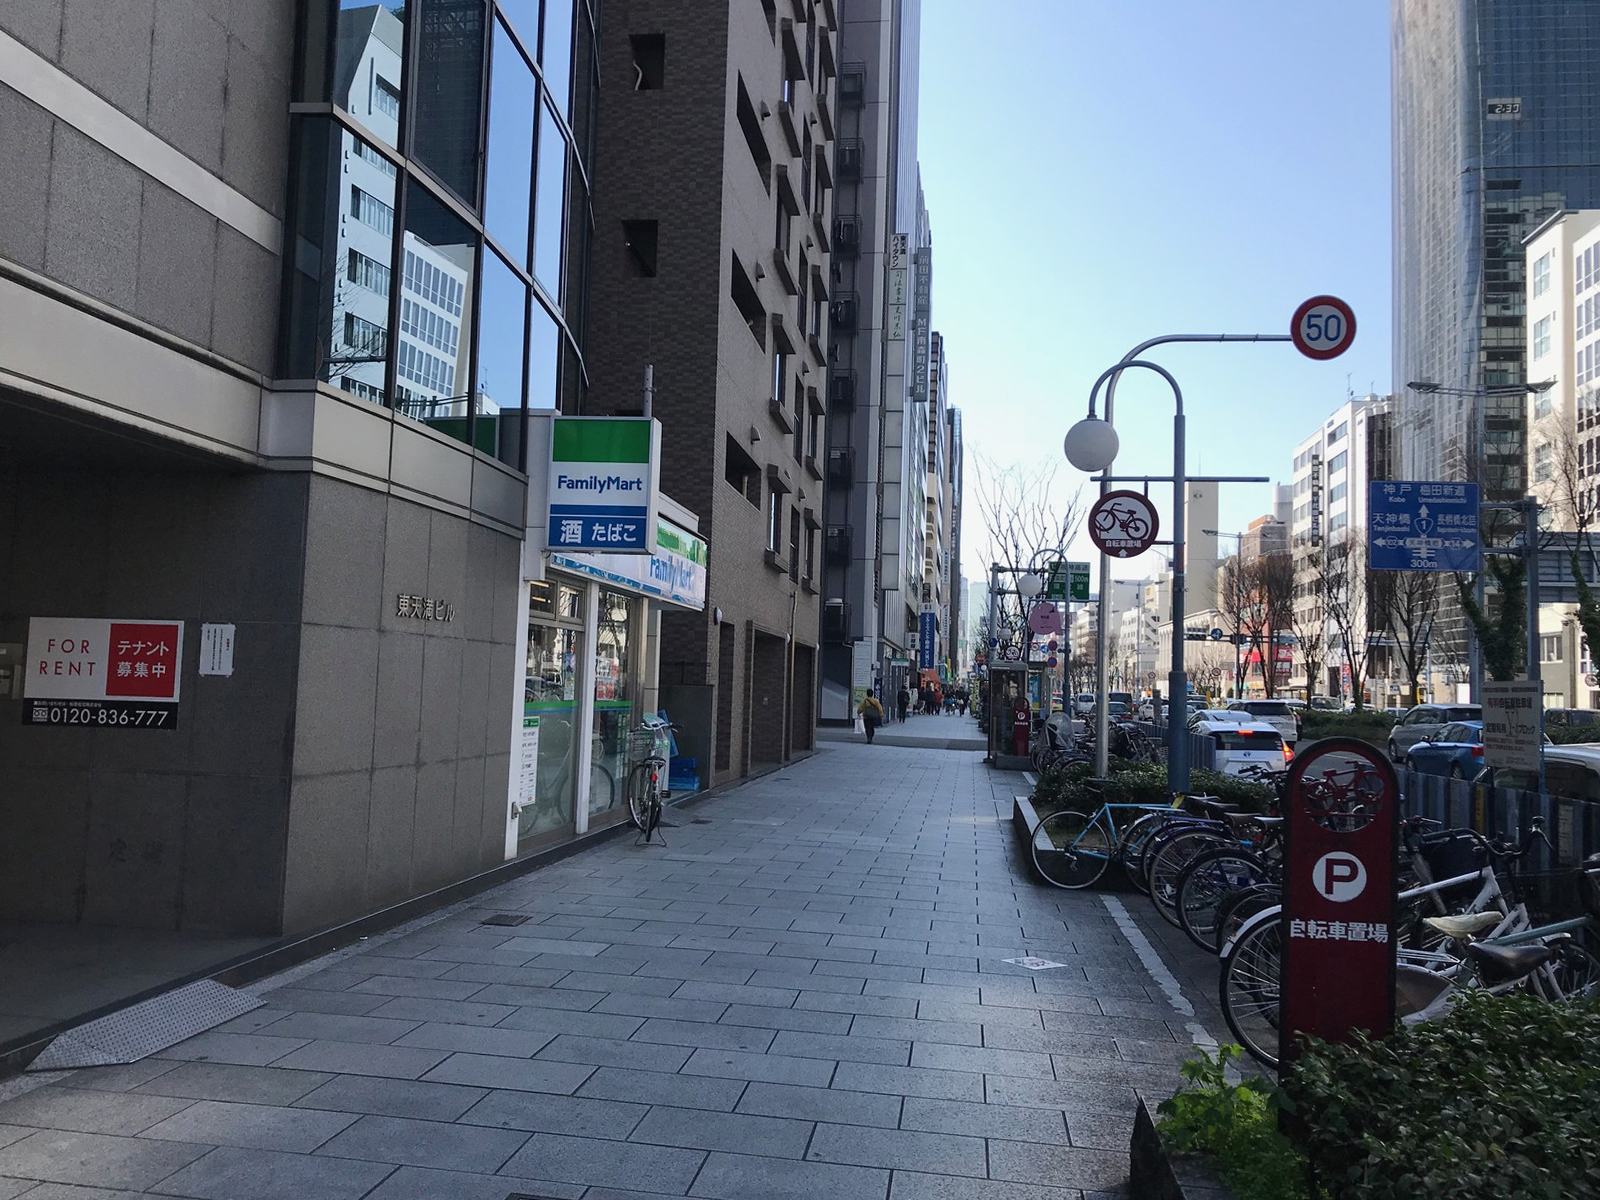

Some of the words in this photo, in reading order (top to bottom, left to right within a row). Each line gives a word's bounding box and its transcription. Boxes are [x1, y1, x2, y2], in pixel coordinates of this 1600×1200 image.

[892, 236, 900, 268] ハイタウン
[894, 271, 902, 303] 司法書士
[1306, 314, 1342, 342] 50
[558, 474, 642, 494] FamilyMart
[1384, 484, 1412, 496] 神戸
[1420, 484, 1465, 496] 梅田新道
[1372, 513, 1411, 524] 天神橋
[1421, 520, 1426, 530] 1
[560, 520, 583, 544] 酒
[592, 522, 637, 542] たばこ
[1106, 540, 1142, 548] 自転車置場
[1410, 560, 1438, 568] 300m
[397, 594, 456, 622] 東天満ビル
[48, 638, 90, 654] FOR
[118, 640, 170, 656] テナント
[39, 661, 96, 676] RENT
[117, 662, 166, 678] 募集中
[50, 708, 168, 726] 0120-836-777
[1325, 858, 1359, 895] P
[1290, 918, 1389, 943] 自転車置場
